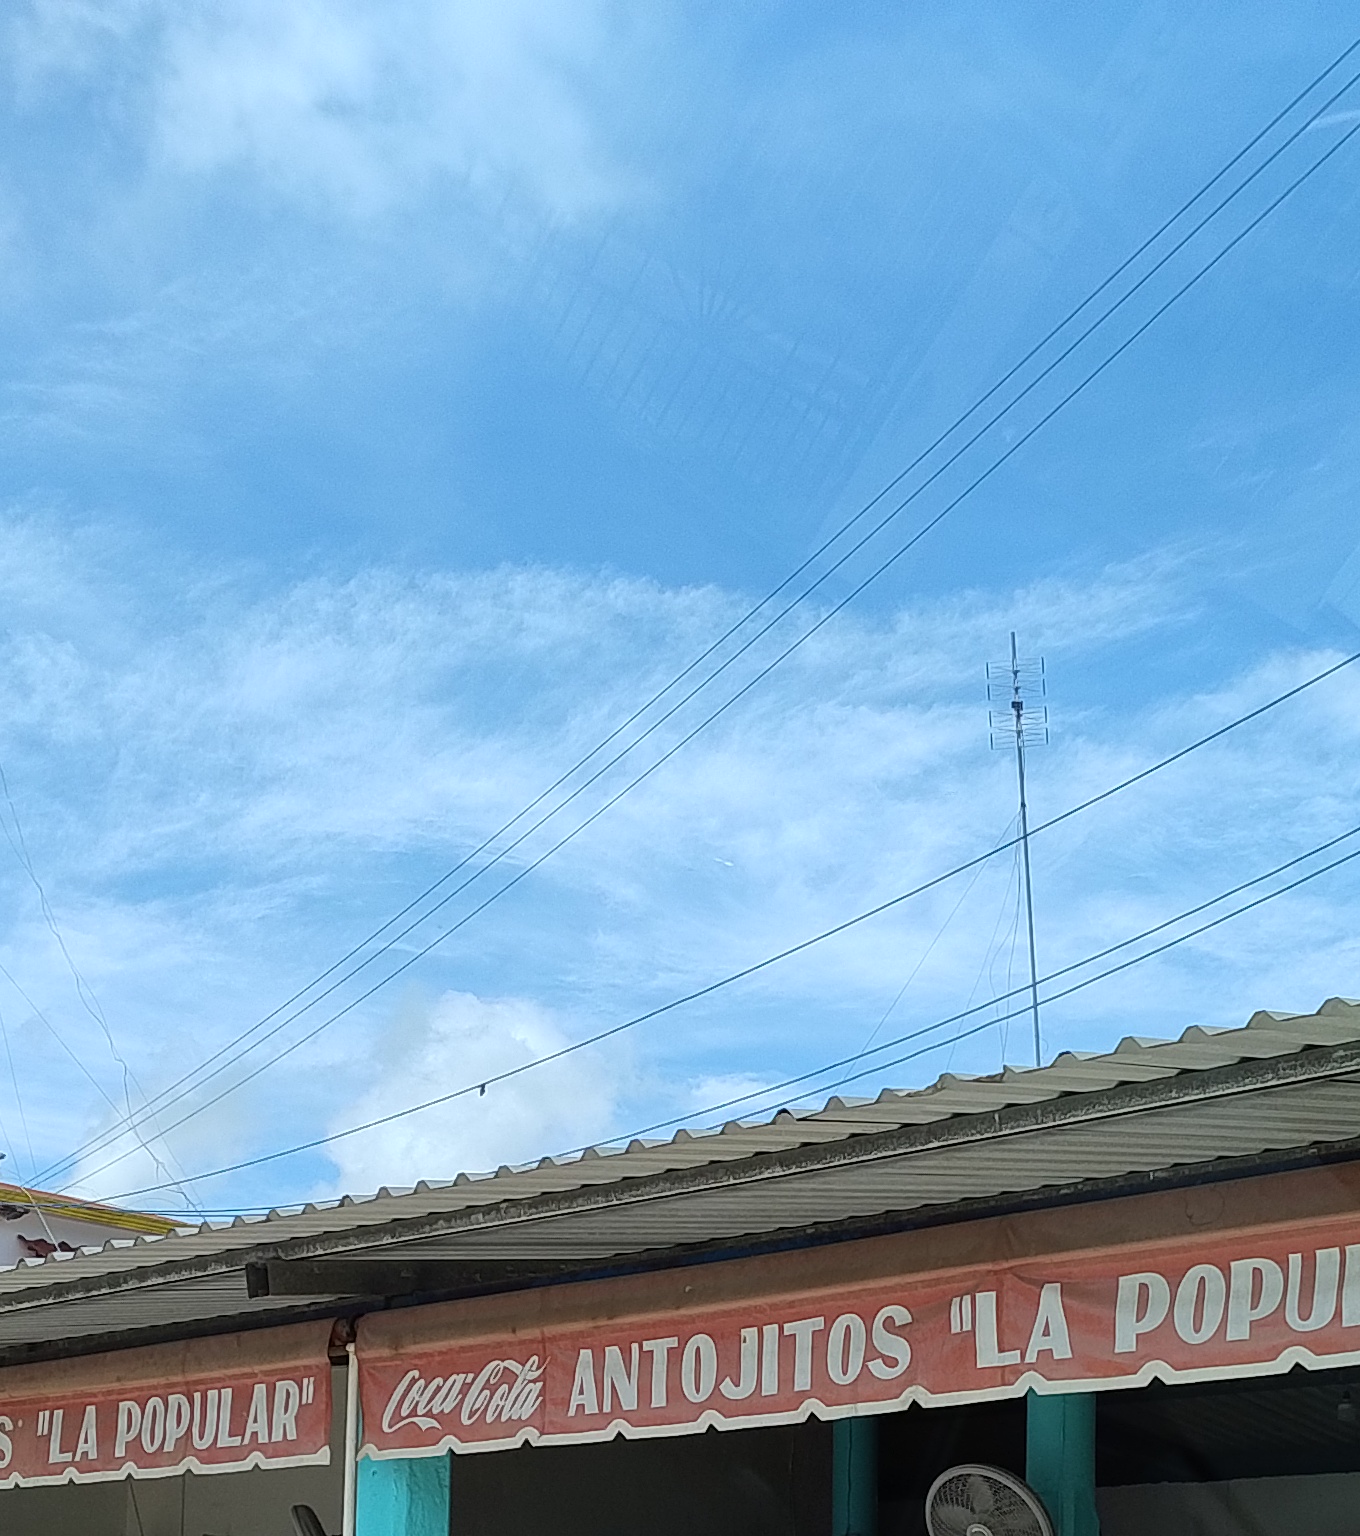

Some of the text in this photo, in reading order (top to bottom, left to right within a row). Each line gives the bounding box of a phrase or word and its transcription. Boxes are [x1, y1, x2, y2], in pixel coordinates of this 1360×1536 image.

[381, 1354, 550, 1434] Coca-Cola
[567, 1304, 914, 1418] ANTOJITOS
[950, 1282, 1073, 1369] "LA
[36, 1403, 98, 1465] "LA
[114, 1376, 315, 1458] POPULAR"
